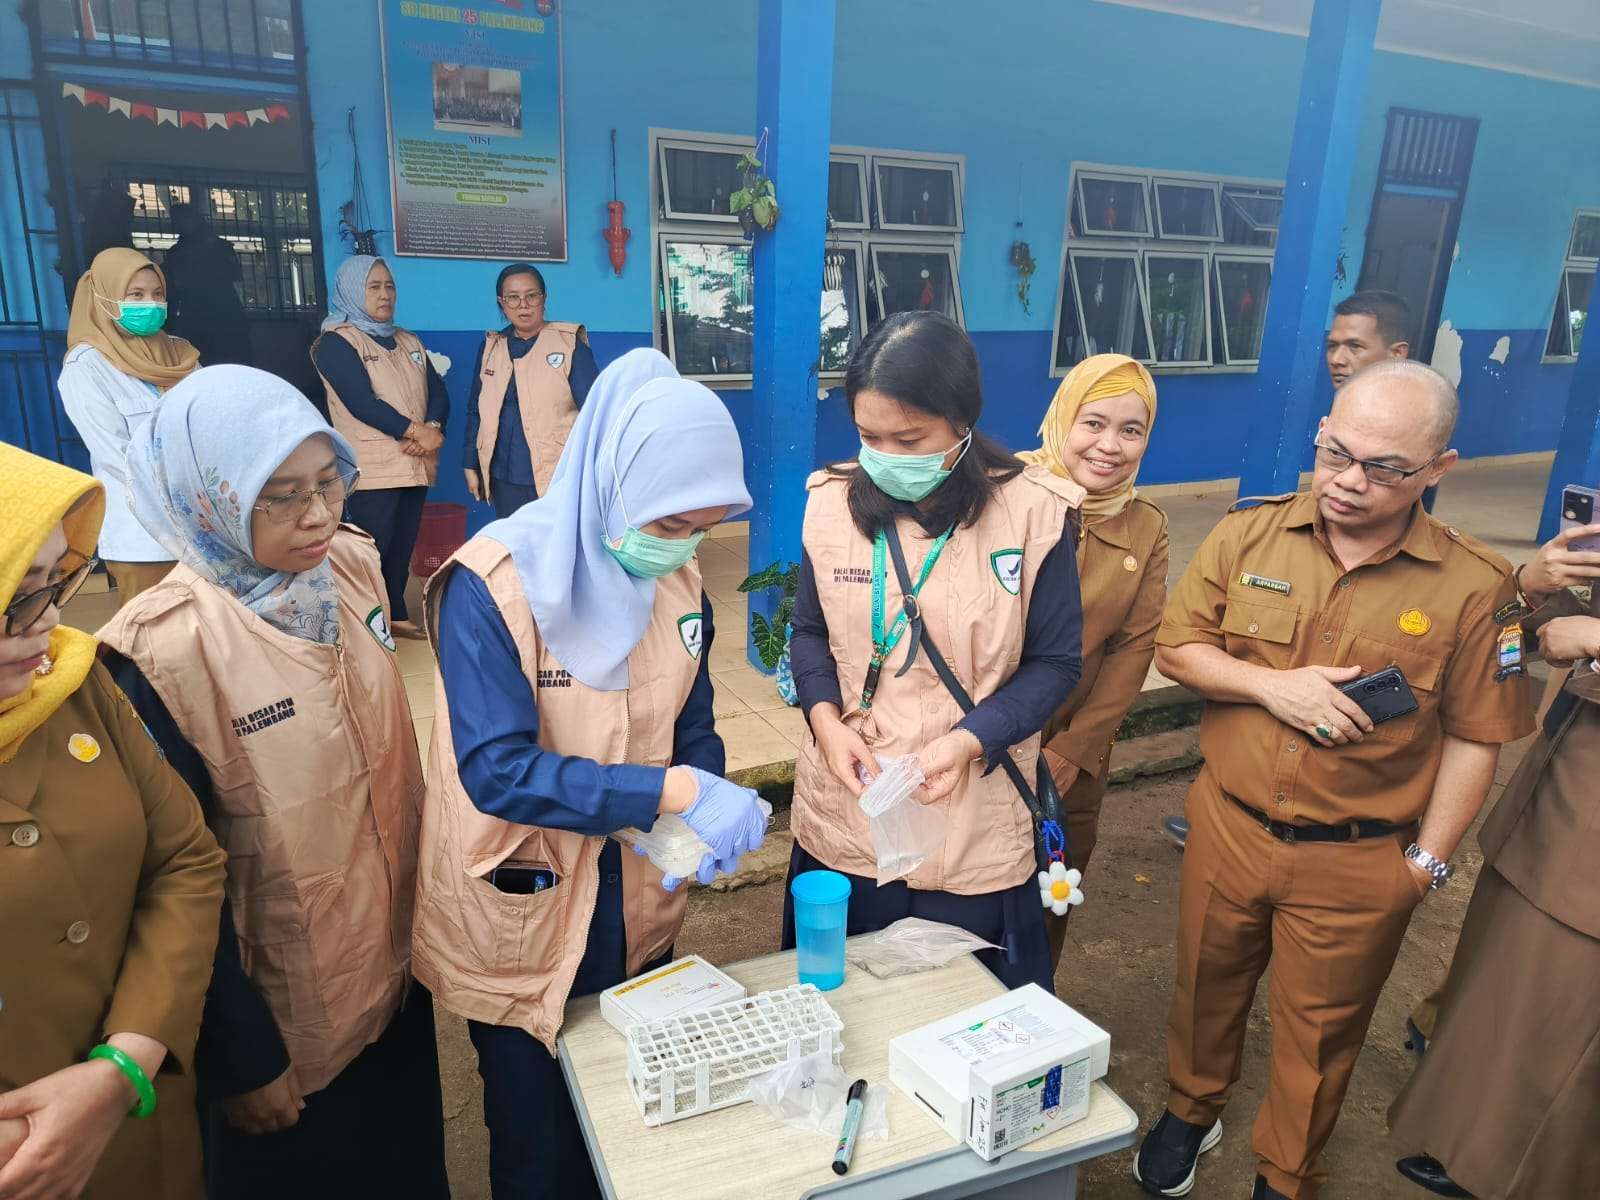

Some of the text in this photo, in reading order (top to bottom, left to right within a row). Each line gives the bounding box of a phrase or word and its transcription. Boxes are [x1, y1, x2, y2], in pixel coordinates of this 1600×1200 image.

[463, 8, 478, 24] 25
[469, 135, 490, 145] MISI
[247, 705, 276, 723] BESAR
[276, 697, 295, 710] POM
[241, 707, 296, 736] PALEMBANG
